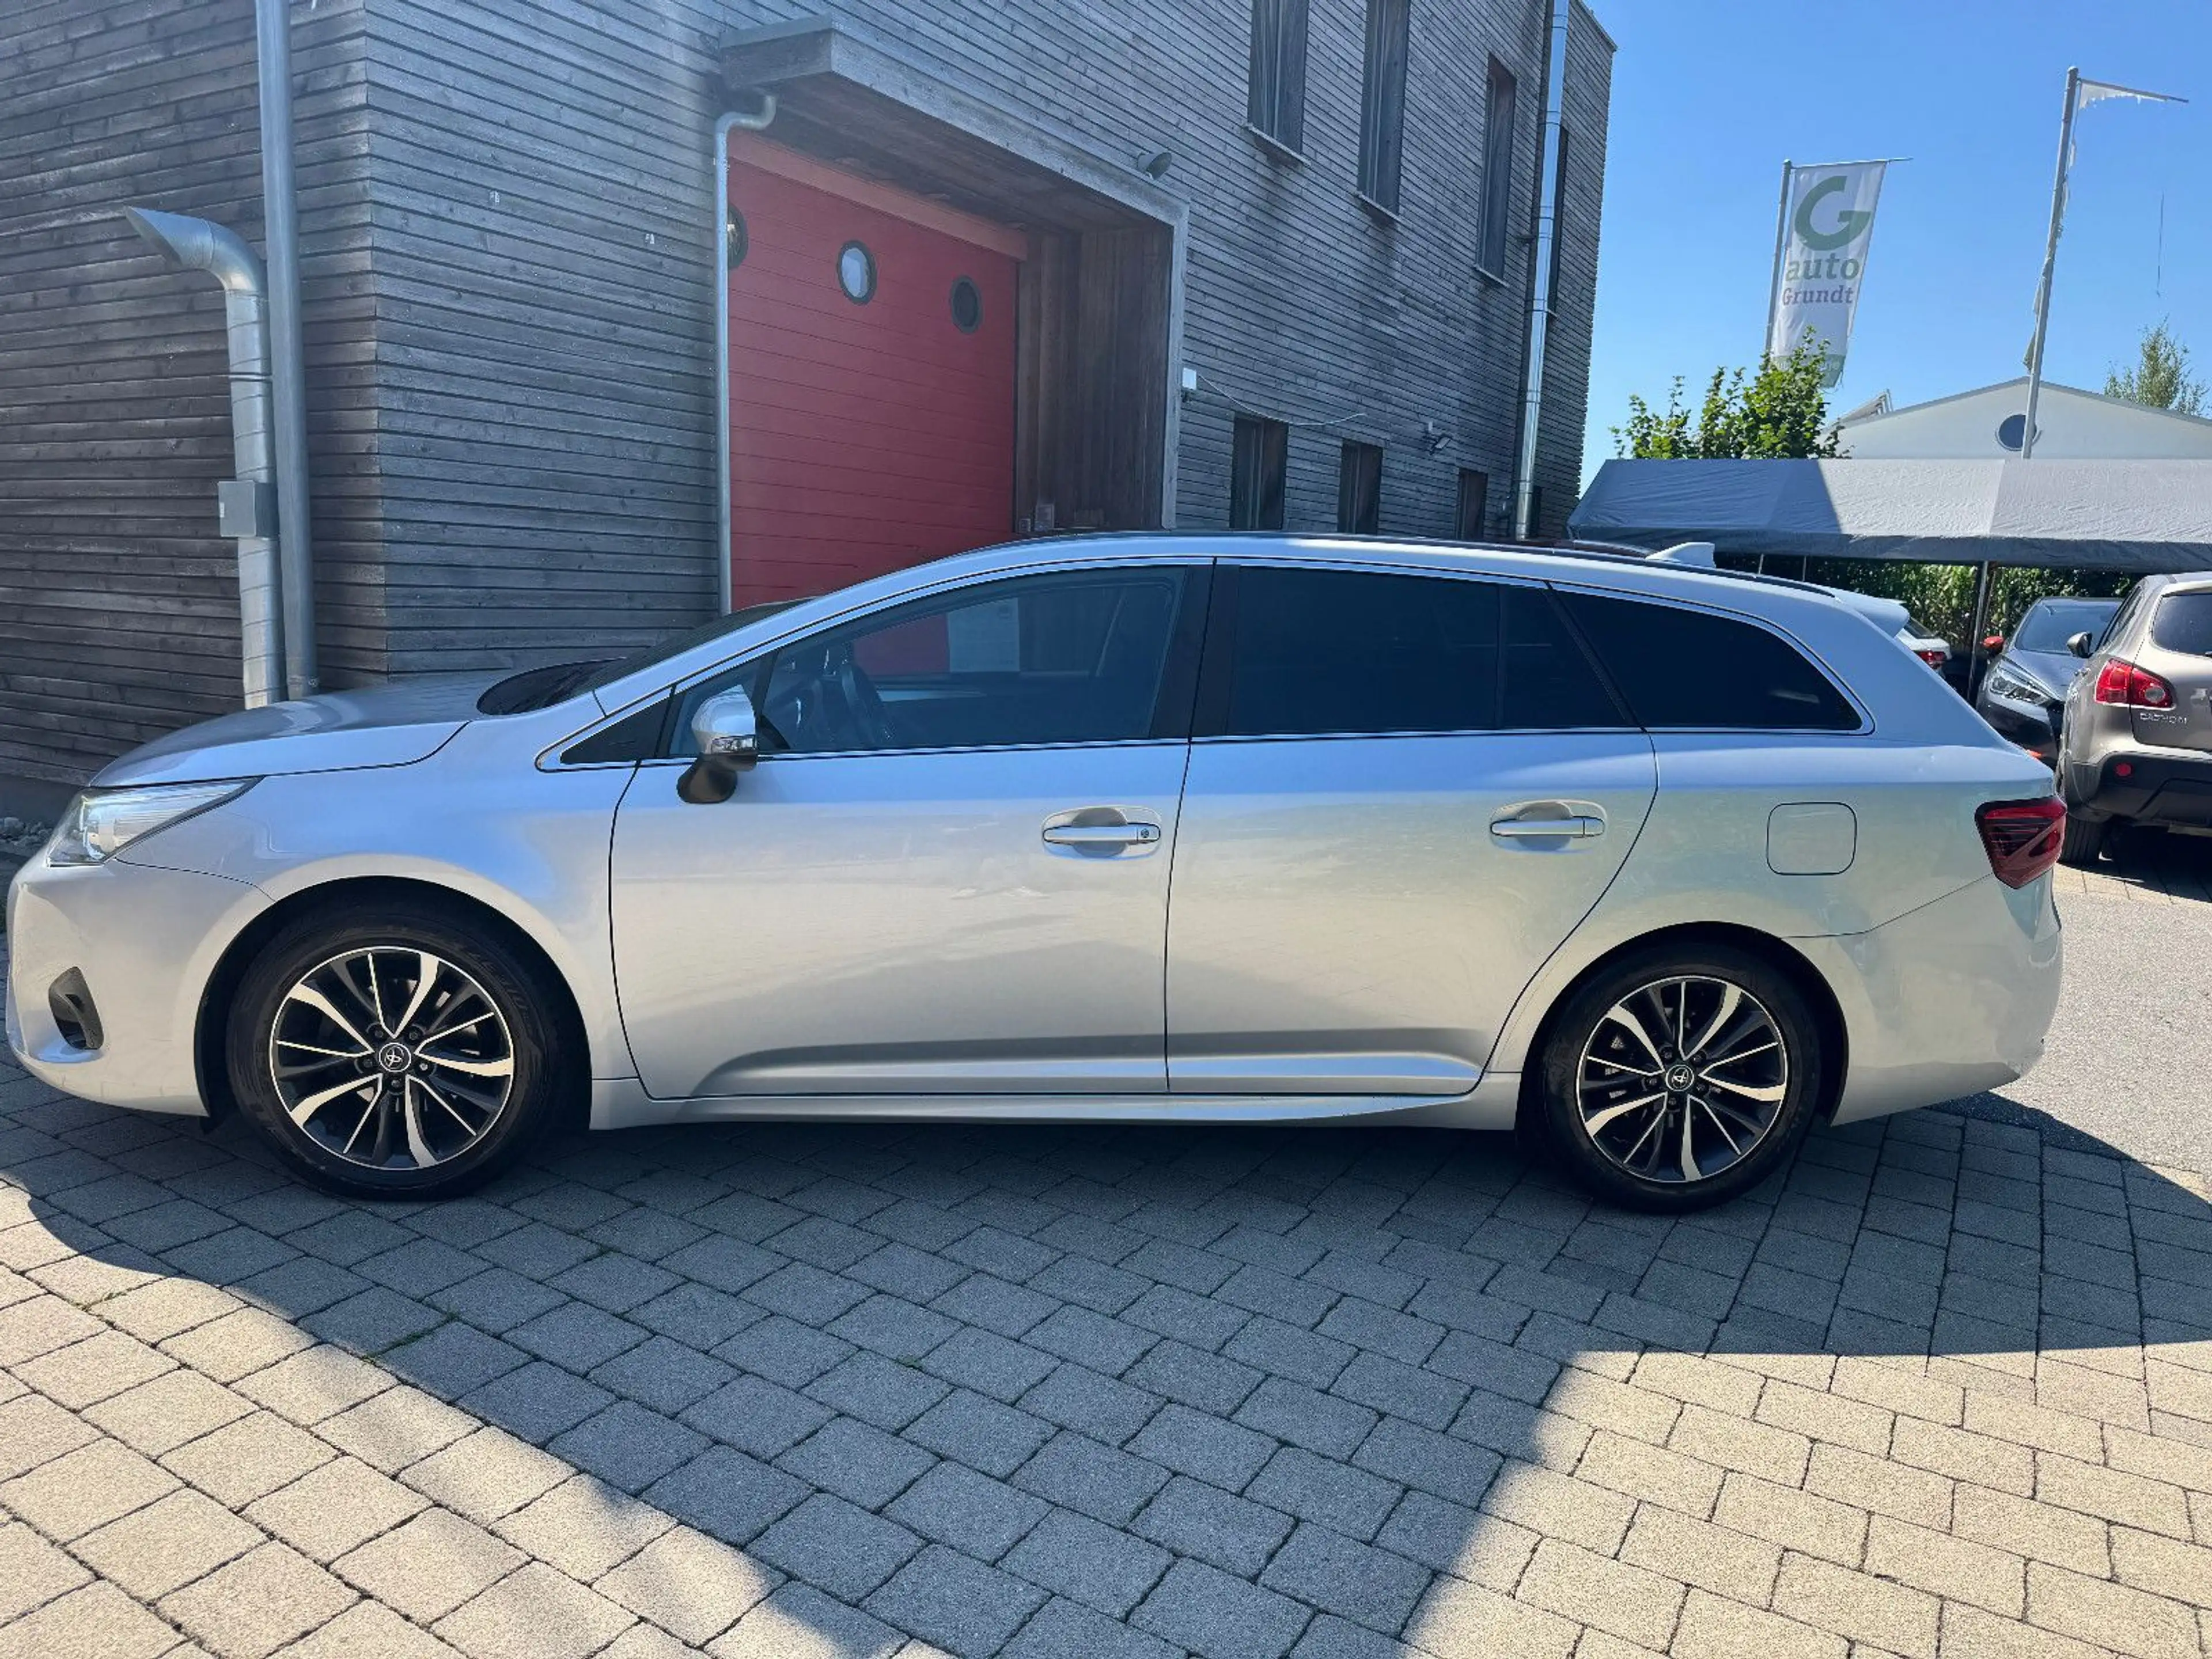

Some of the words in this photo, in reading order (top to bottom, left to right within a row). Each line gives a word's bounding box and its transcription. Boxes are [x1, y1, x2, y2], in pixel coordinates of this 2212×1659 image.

[1794, 175, 1871, 251] G
[1786, 252, 1859, 281] auto
[1782, 285, 1854, 305] Grundt
